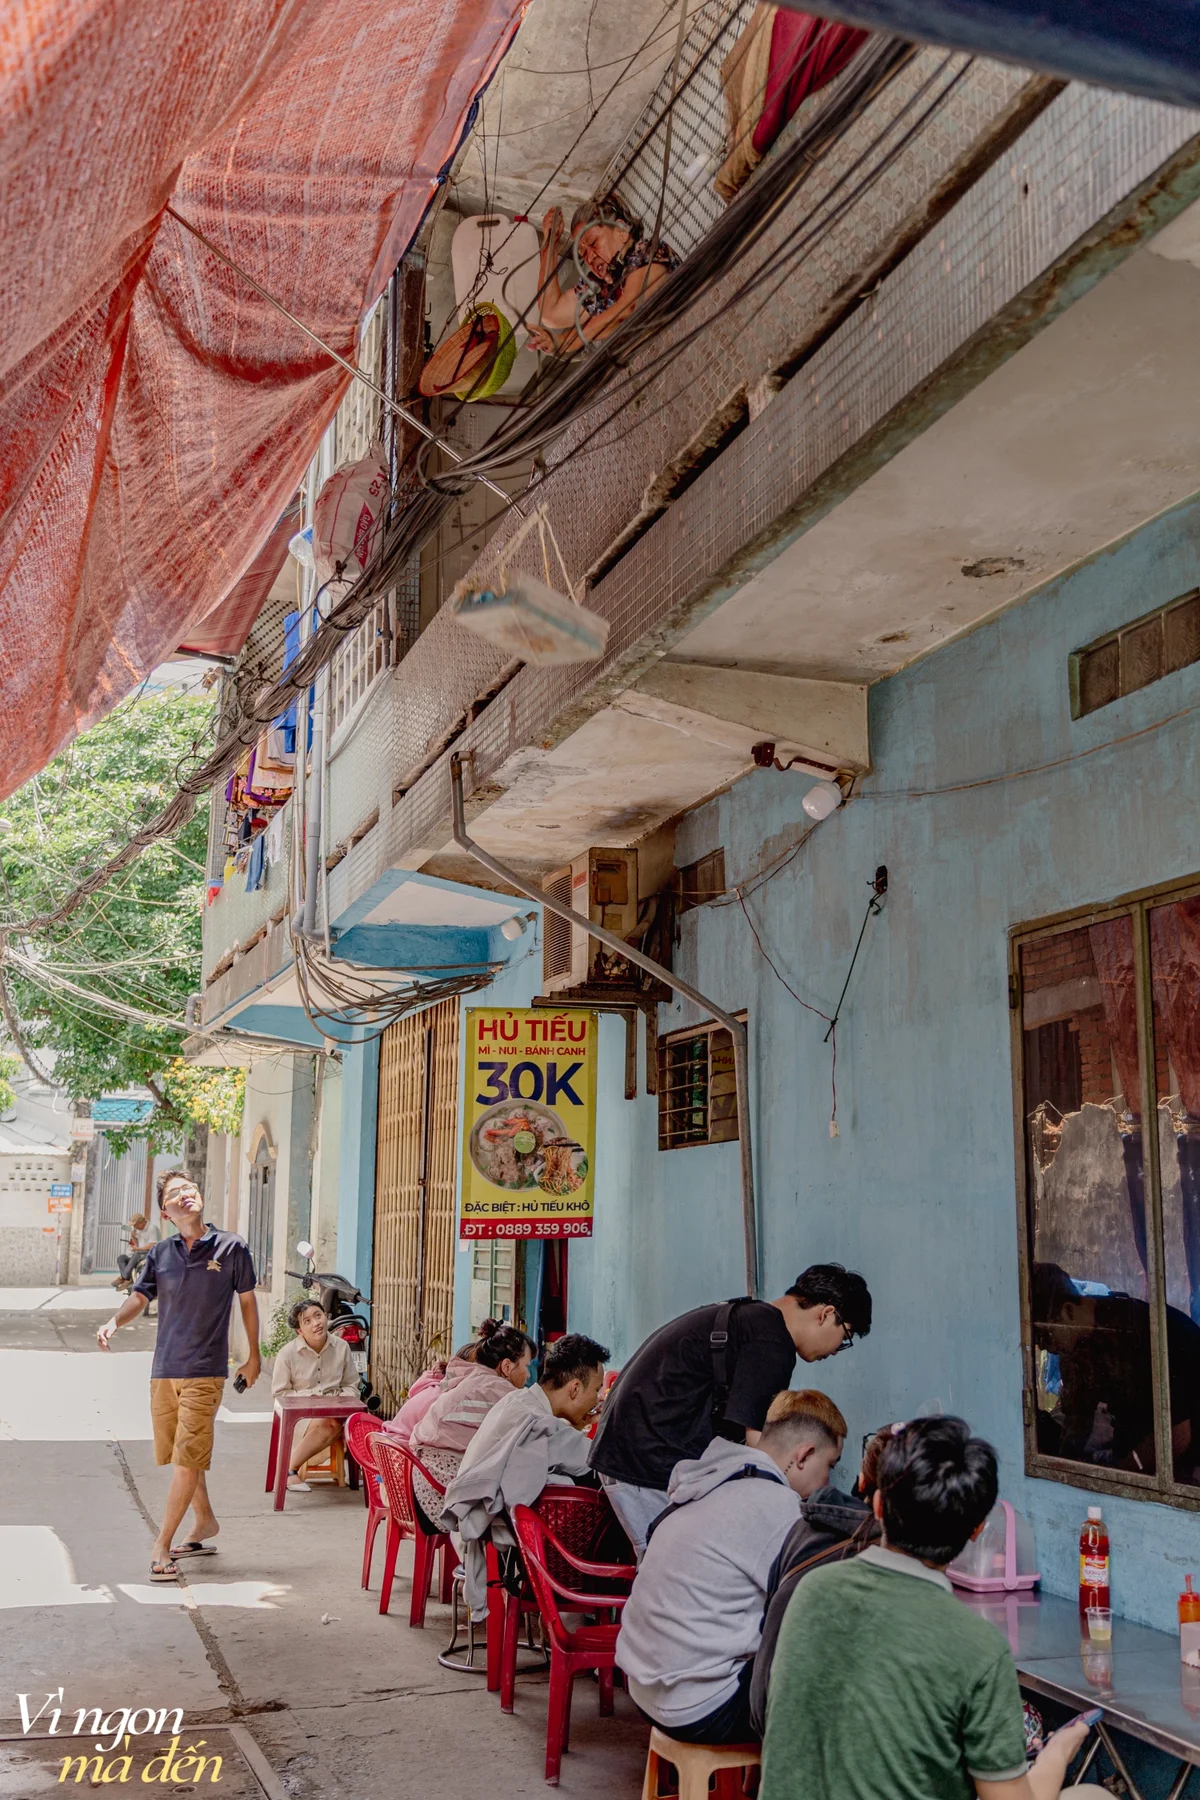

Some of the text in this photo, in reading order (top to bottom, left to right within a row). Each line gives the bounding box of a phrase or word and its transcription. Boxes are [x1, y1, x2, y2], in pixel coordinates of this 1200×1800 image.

[478, 1011, 587, 1042] HỦ TIẾU
[478, 1044, 586, 1056] MÌ NUI BÁNH CANH
[475, 1061, 585, 1107] 30K
[464, 1199, 590, 1215] ĐẶC BIỆT HỦ TIẾU KHÔ
[464, 1222, 589, 1236] ĐT 0889 359 906
